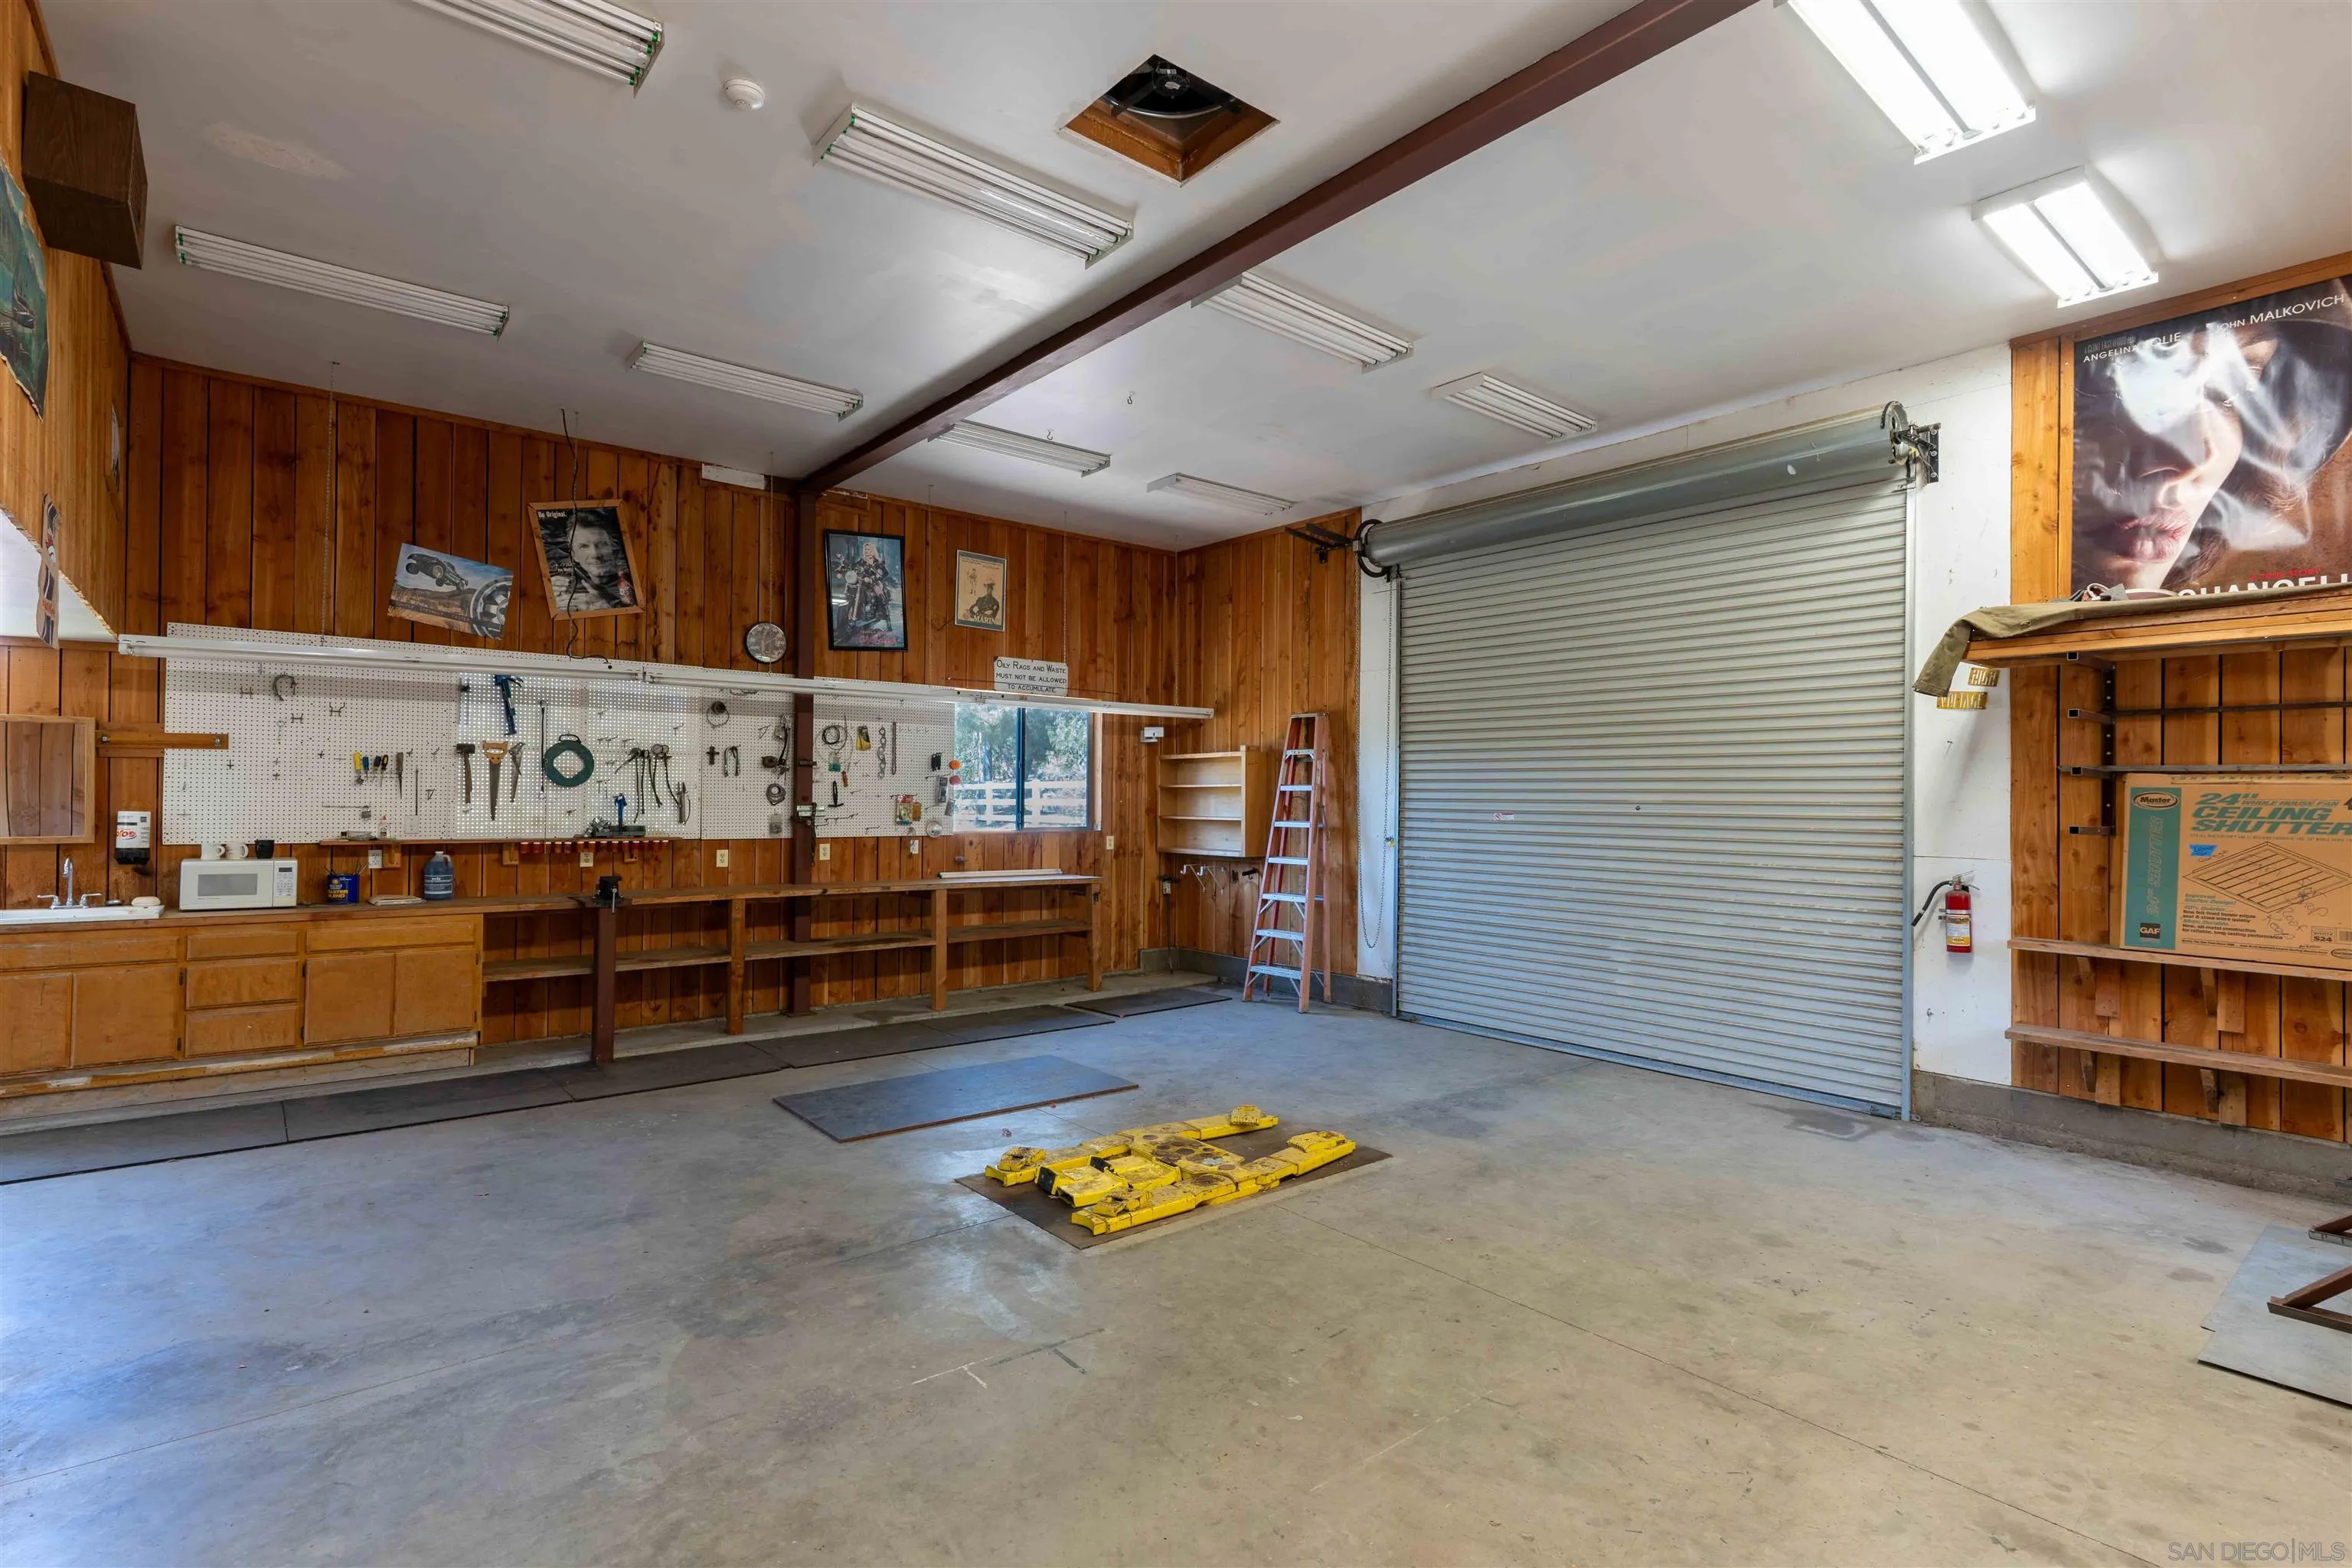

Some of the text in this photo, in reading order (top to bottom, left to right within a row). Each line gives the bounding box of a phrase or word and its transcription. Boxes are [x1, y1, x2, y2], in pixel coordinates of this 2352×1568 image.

[2250, 294, 2344, 325] MALKOVICH
[2083, 332, 2181, 363] ANGELINA OLIE
[1012, 661, 1031, 671] RAGS
[1046, 664, 1067, 675] WASTE
[1018, 684, 1056, 693] ACCUMULATE
[2196, 793, 2259, 805] 24"
[2193, 806, 2332, 822] CEILING
[2190, 818, 2352, 836] SHUTTER
[2148, 815, 2163, 887] SHUTTER
